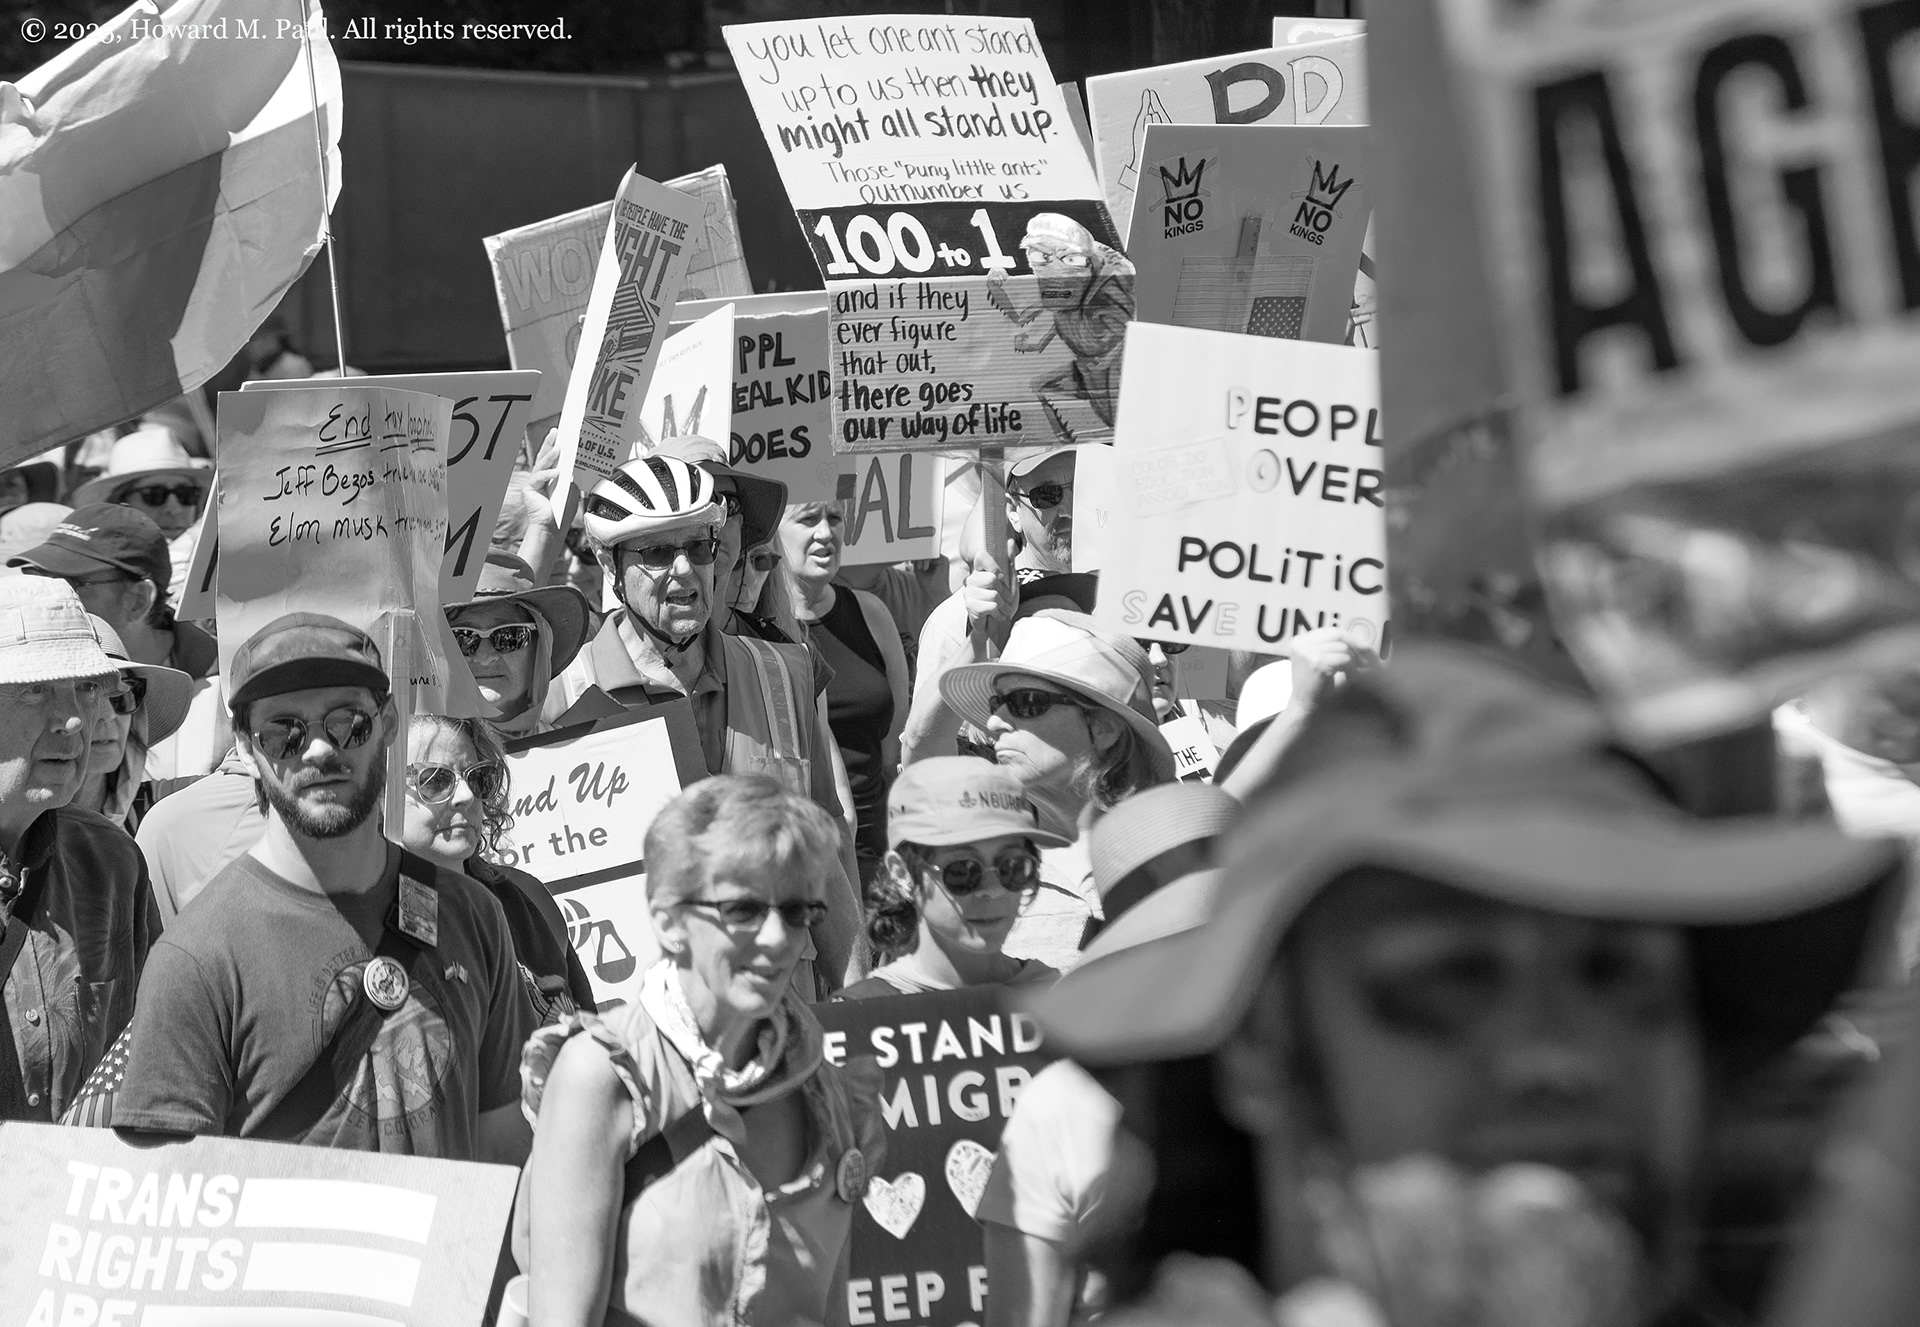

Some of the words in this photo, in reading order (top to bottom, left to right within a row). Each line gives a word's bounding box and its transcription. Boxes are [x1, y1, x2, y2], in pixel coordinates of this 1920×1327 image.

[746, 33, 815, 84] you
[819, 25, 862, 59] let
[868, 25, 914, 54] one
[917, 24, 960, 55] ant
[965, 24, 1039, 58] stand
[867, 77, 904, 101] us
[905, 66, 968, 99] then
[968, 64, 1036, 106] they
[777, 108, 871, 159] might
[881, 109, 921, 138] all
[924, 101, 1008, 139] stand
[1010, 109, 1059, 143] up.
[823, 161, 895, 184] Those
[952, 158, 996, 177] little
[1001, 159, 1049, 176] ants"
[1000, 182, 1030, 200] us
[647, 210, 671, 235] HAVE
[668, 219, 689, 240] THE
[1164, 199, 1205, 227] NO
[1164, 220, 1205, 239] KINGS
[1294, 201, 1333, 233] NO
[814, 212, 935, 275] 100
[937, 243, 971, 267] to
[970, 208, 1017, 269] 1
[1289, 223, 1325, 246] KINGS
[836, 286, 879, 314] and
[888, 282, 908, 309] if
[916, 281, 970, 321] they
[836, 319, 883, 344] ever
[889, 315, 957, 348] figure
[738, 332, 796, 375] PPL
[839, 350, 889, 377] that
[896, 348, 936, 374] out,
[838, 380, 911, 412] there
[919, 380, 974, 411] goes
[317, 403, 372, 442] End
[842, 415, 894, 443] our
[899, 410, 953, 442] way
[952, 406, 984, 435] of
[983, 402, 1022, 436] life
[584, 440, 598, 452] OF
[597, 444, 616, 460] U.S.
[729, 425, 812, 467] DOES
[1130, 450, 1207, 476] COLORDO
[263, 465, 316, 501] Jeff
[321, 464, 376, 506] Bezos
[1134, 464, 1215, 493] EDUCTION
[1136, 478, 1231, 508] ASSOCITION
[1245, 448, 1385, 508] OVER
[835, 453, 936, 546] AL
[268, 511, 320, 546] Elon
[1122, 590, 1240, 636] SAVE
[1173, 746, 1202, 768] THE
[567, 761, 630, 809] Up
[548, 824, 608, 857] the
[870, 1013, 1045, 1069] STAND
[65, 1160, 240, 1228] TRANS
[38, 1222, 244, 1291] RIGHTS
